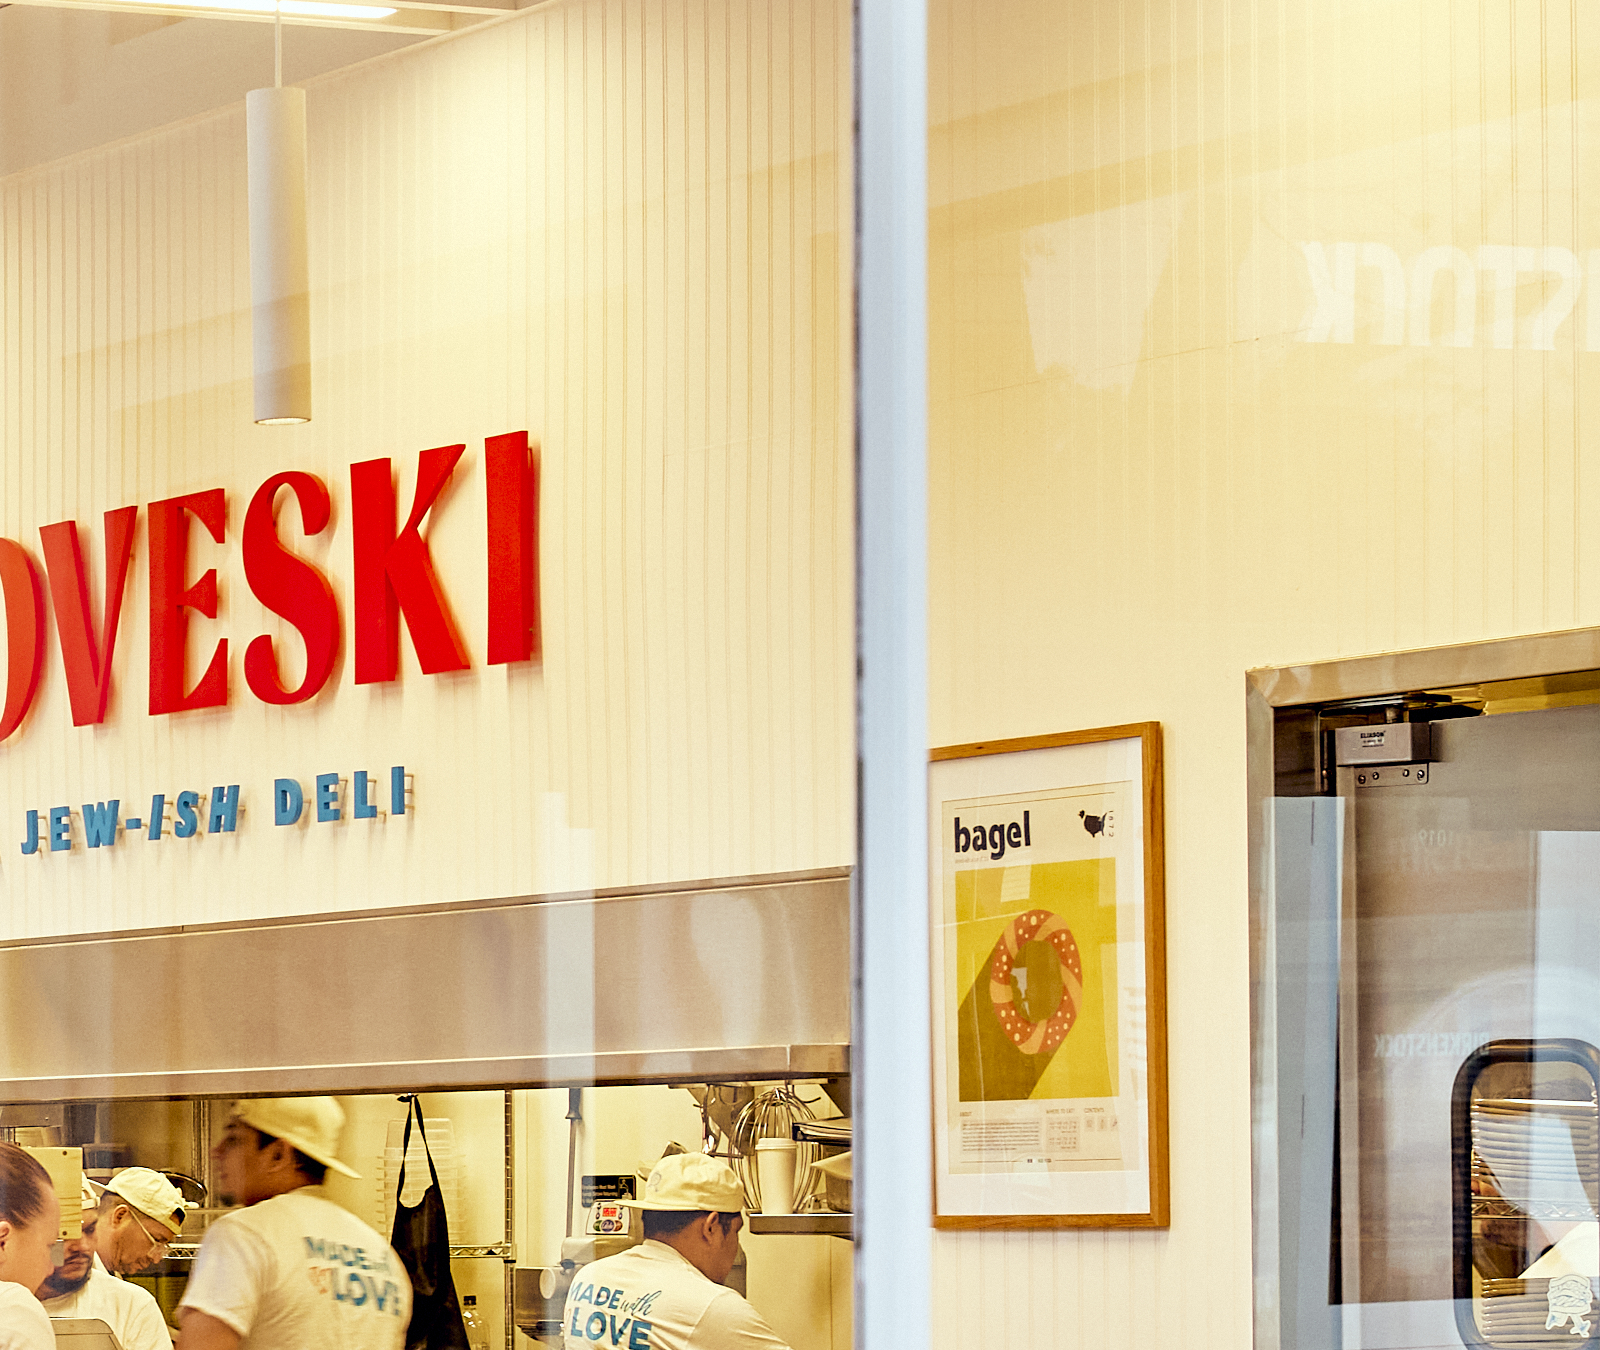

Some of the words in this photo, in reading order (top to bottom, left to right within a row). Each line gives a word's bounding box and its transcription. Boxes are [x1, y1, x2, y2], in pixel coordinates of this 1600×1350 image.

[21, 784, 240, 854] JEW-ISH
[274, 766, 406, 827] DELI
[954, 810, 1031, 861] bagel
[570, 1282, 624, 1309] MADE
[620, 1290, 662, 1316] with
